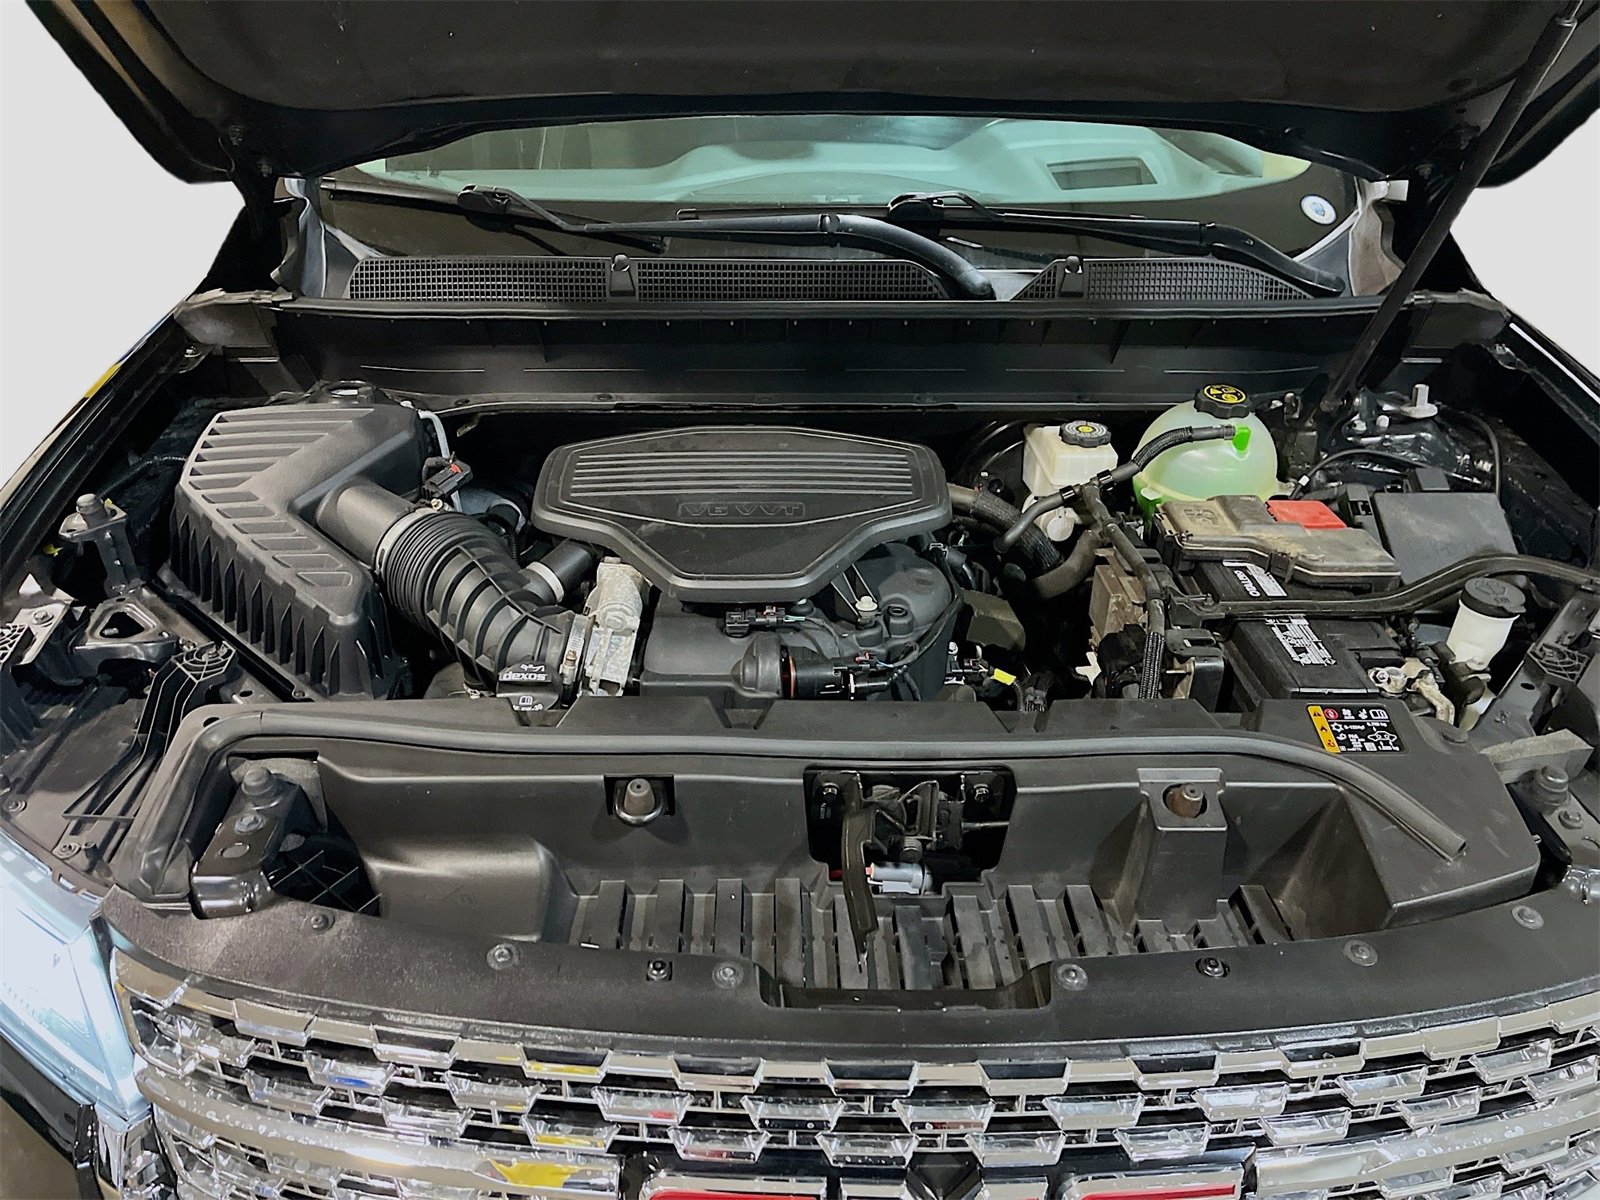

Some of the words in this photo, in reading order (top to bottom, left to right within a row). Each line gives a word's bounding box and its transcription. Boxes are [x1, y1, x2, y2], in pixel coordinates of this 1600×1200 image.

[684, 502, 729, 517] V6
[734, 502, 800, 516] VVT
[502, 671, 548, 681] dexos
